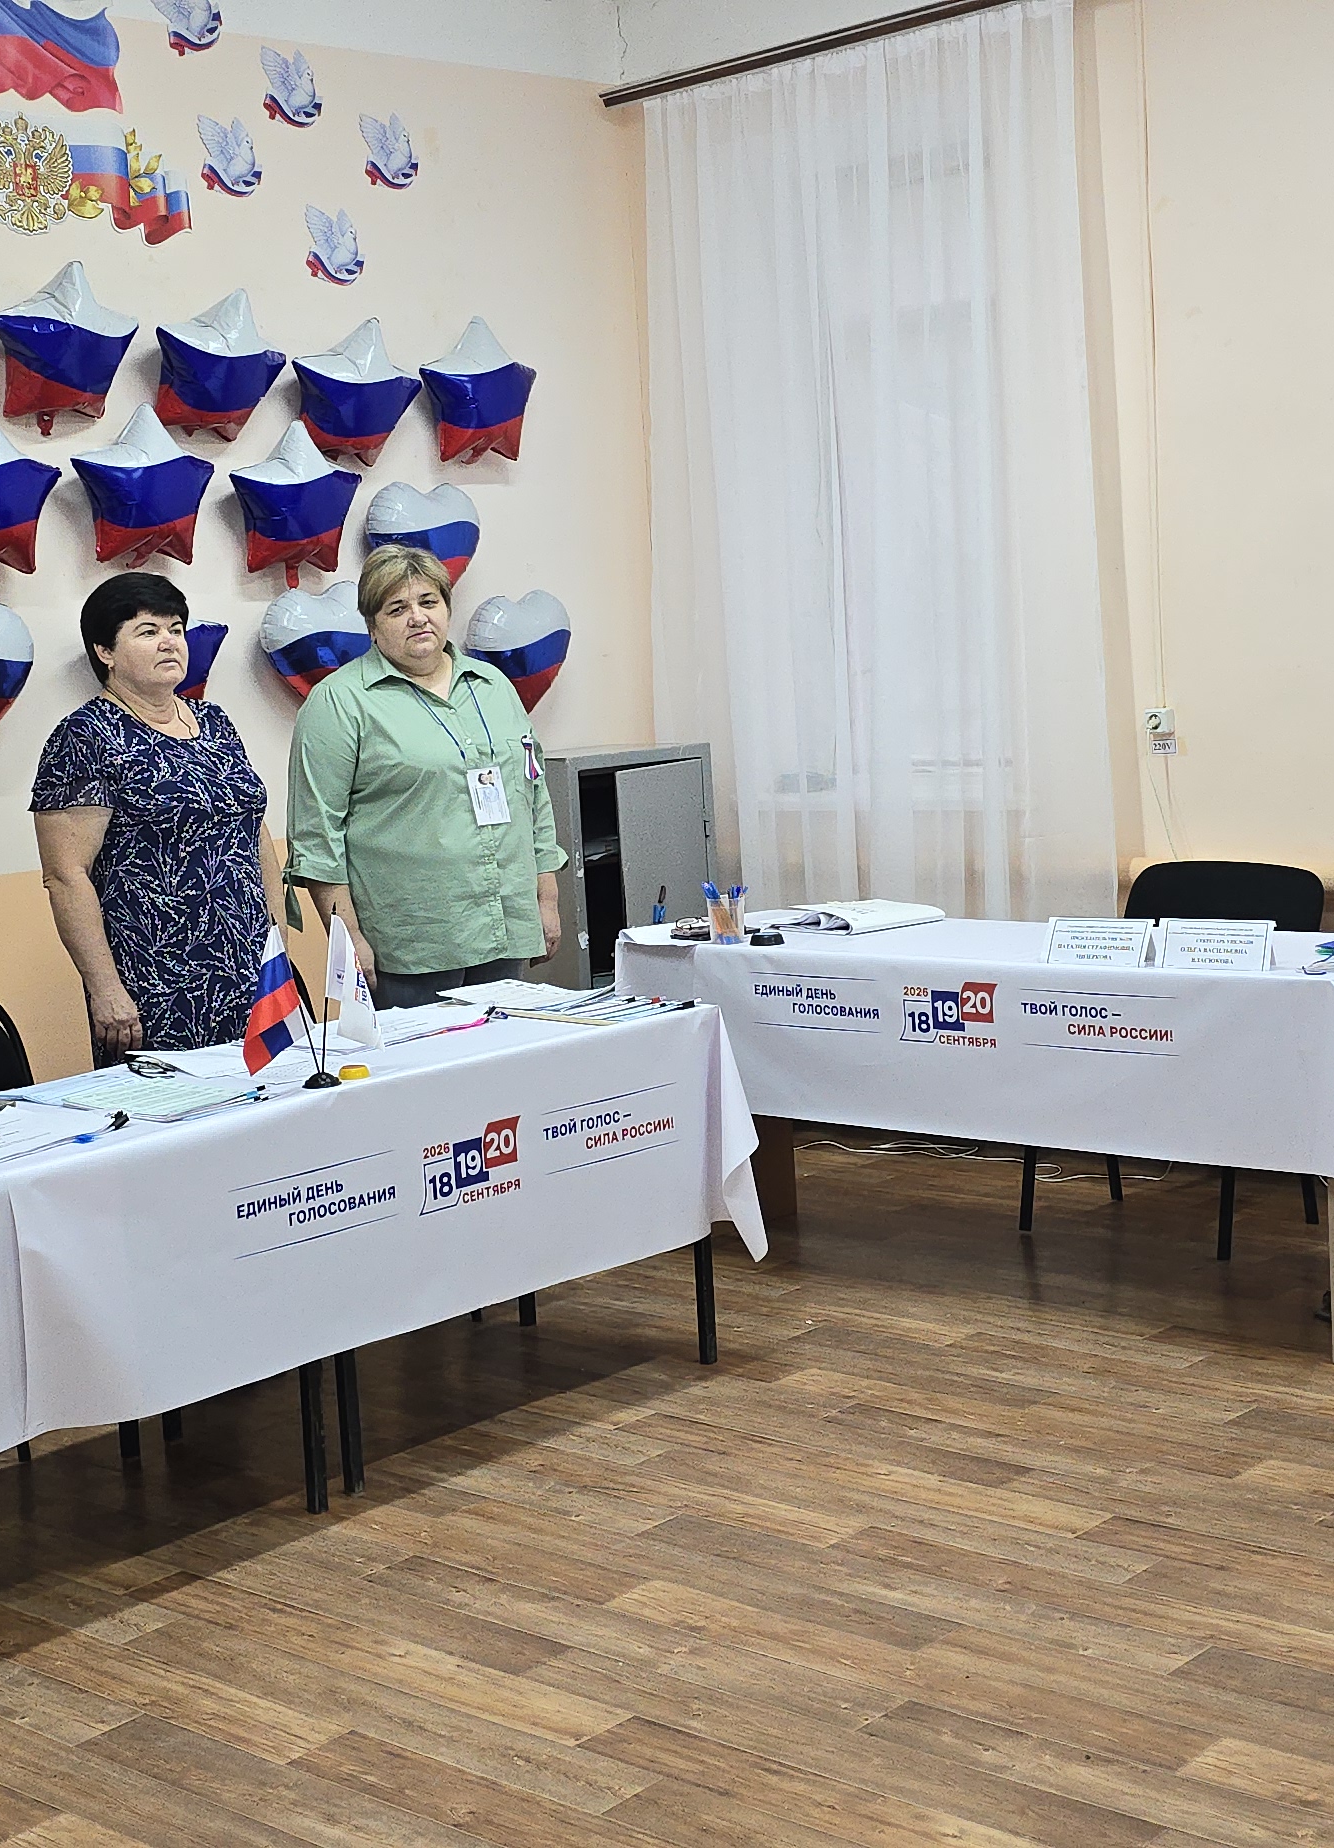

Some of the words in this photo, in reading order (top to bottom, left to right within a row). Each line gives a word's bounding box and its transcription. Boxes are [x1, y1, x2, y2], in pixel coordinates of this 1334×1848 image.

[1153, 742, 1172, 751] 220V
[754, 984, 803, 997] ЕДИНЫЙ
[806, 988, 836, 1000] ДЕНЬ
[903, 986, 929, 997] 2026
[792, 1003, 880, 1019] ГОЛОСОВАНИЯ
[908, 1011, 931, 1033] 18
[934, 1000, 958, 1023] 19
[962, 991, 991, 1014] 20
[1021, 1001, 1058, 1016] ТВОЙ
[1061, 1004, 1108, 1019] ГОЛОС
[939, 1034, 997, 1048] СЕНТЯБРЯ
[1067, 1023, 1106, 1037] СИЛА
[1110, 1026, 1173, 1042] РОССИИ!
[543, 1118, 577, 1140] ТВОЙ
[580, 1111, 621, 1132] ГОЛОС
[585, 1131, 619, 1149] СИЛА
[622, 1117, 674, 1141] РОССИИ!
[423, 1142, 450, 1159] 2026
[429, 1172, 453, 1200] 18
[457, 1150, 481, 1178] 19
[486, 1129, 514, 1158] 20
[236, 1186, 301, 1219] ЕДИНЫЙ
[305, 1180, 344, 1203] ДЕНЬ
[462, 1178, 521, 1204] СЕНТЯБРЯ
[288, 1185, 396, 1226] ГОЛОСОВАНИЯ
